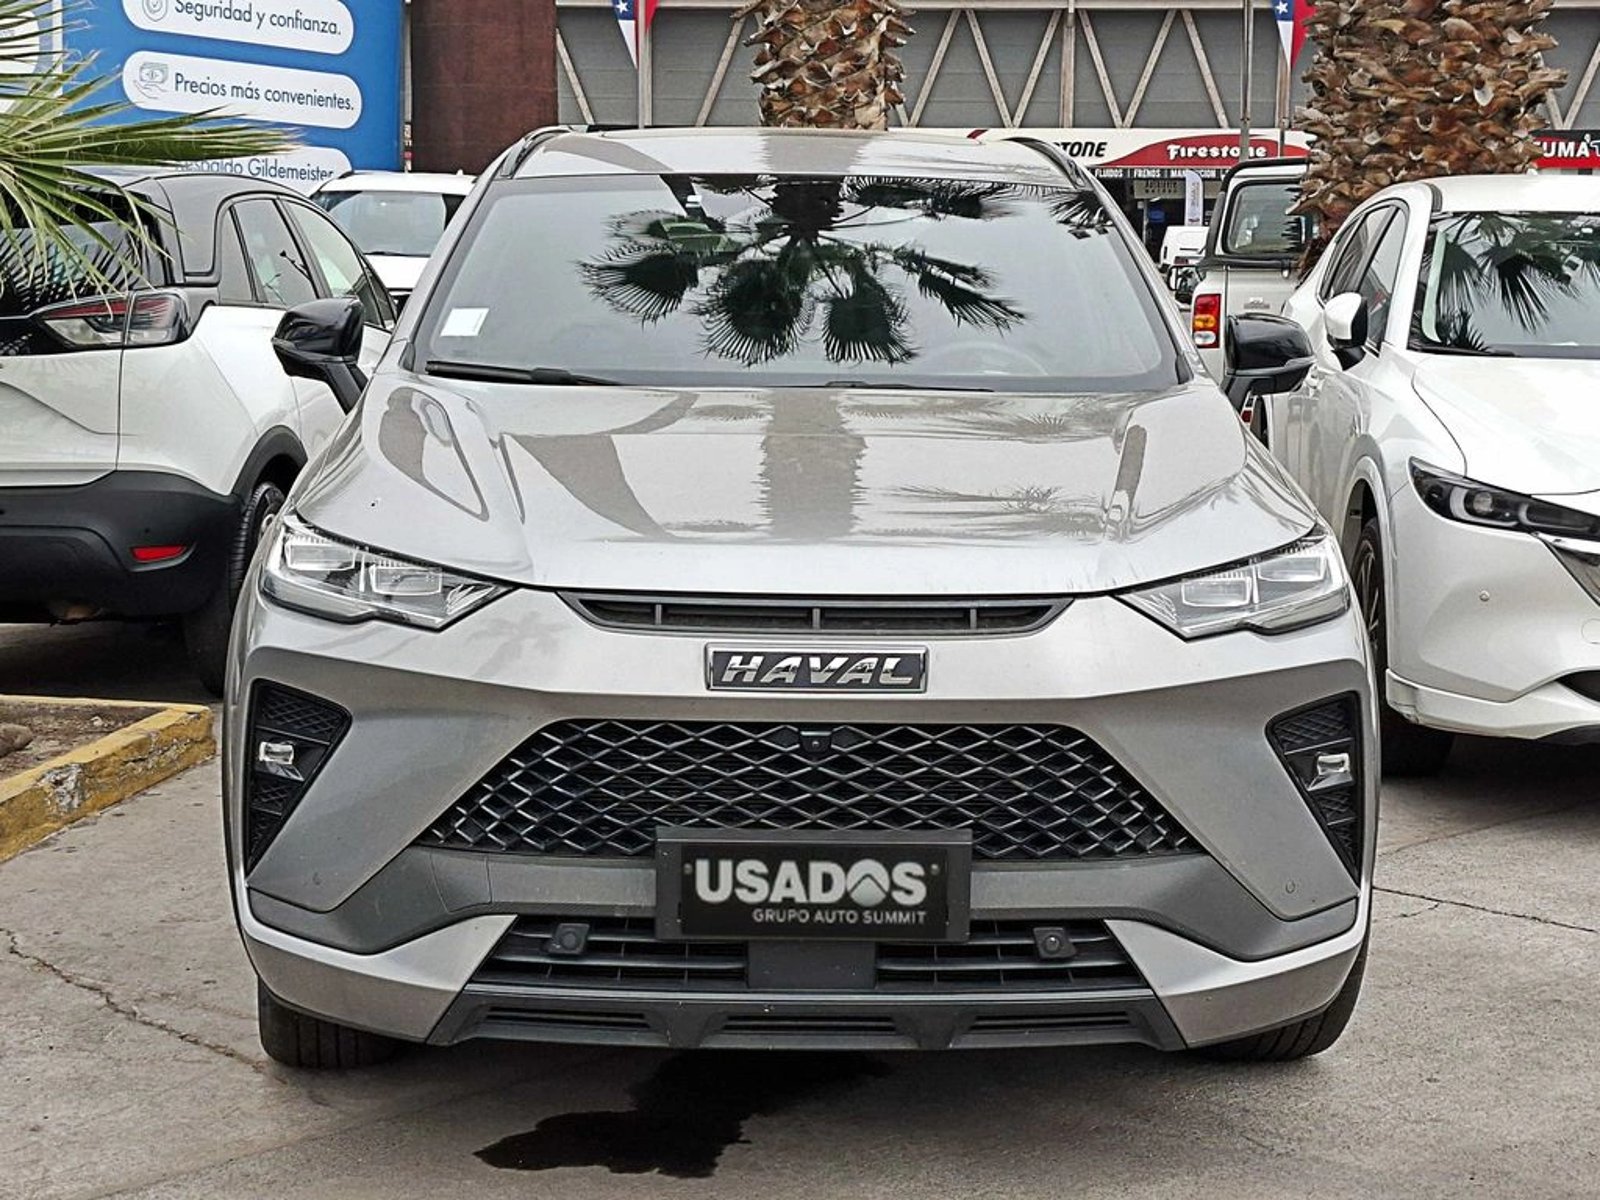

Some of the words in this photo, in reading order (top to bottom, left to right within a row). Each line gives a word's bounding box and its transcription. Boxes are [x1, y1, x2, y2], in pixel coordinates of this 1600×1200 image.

[175, 0, 252, 22] Seguridad
[256, 11, 266, 30] y
[269, 9, 342, 35] confianza.
[174, 73, 227, 97] Precios
[230, 81, 260, 100] más
[264, 89, 354, 110] convenientes.
[1054, 142, 1107, 157] TONE
[247, 158, 334, 180] Gildemeister
[721, 655, 914, 685] HAVAL
[695, 858, 928, 907] USADOS
[752, 908, 810, 924] GRUPO
[813, 909, 860, 924] AUTO
[862, 910, 927, 925] SUMMIT
